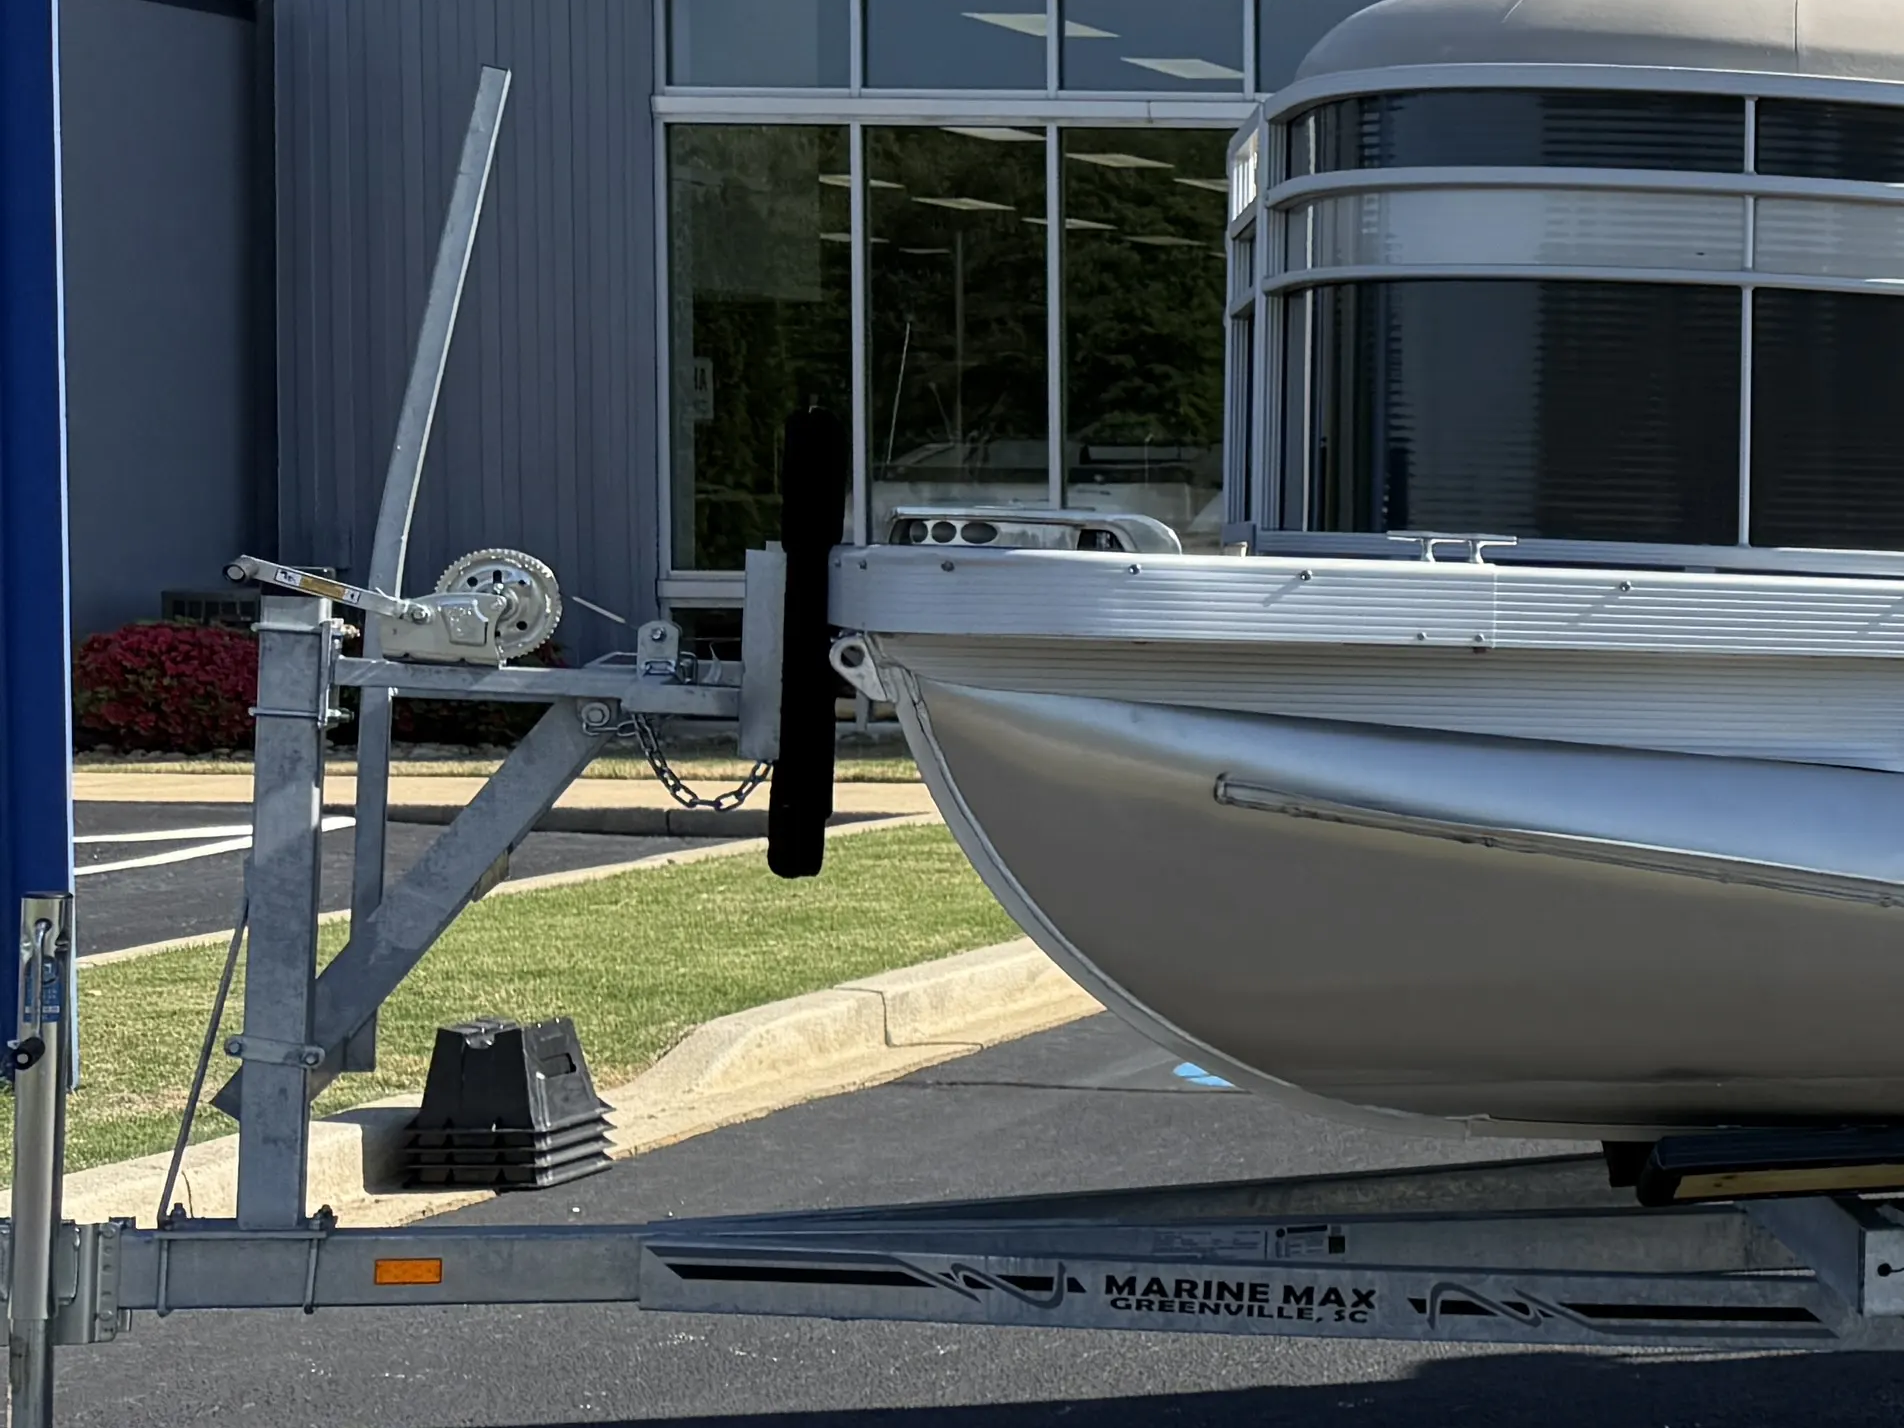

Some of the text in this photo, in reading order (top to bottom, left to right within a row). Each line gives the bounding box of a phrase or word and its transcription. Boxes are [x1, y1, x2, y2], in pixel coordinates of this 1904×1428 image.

[1104, 1274, 1377, 1310] MARINE MAX
[1109, 1297, 1369, 1324] GREENVILLE, SC
